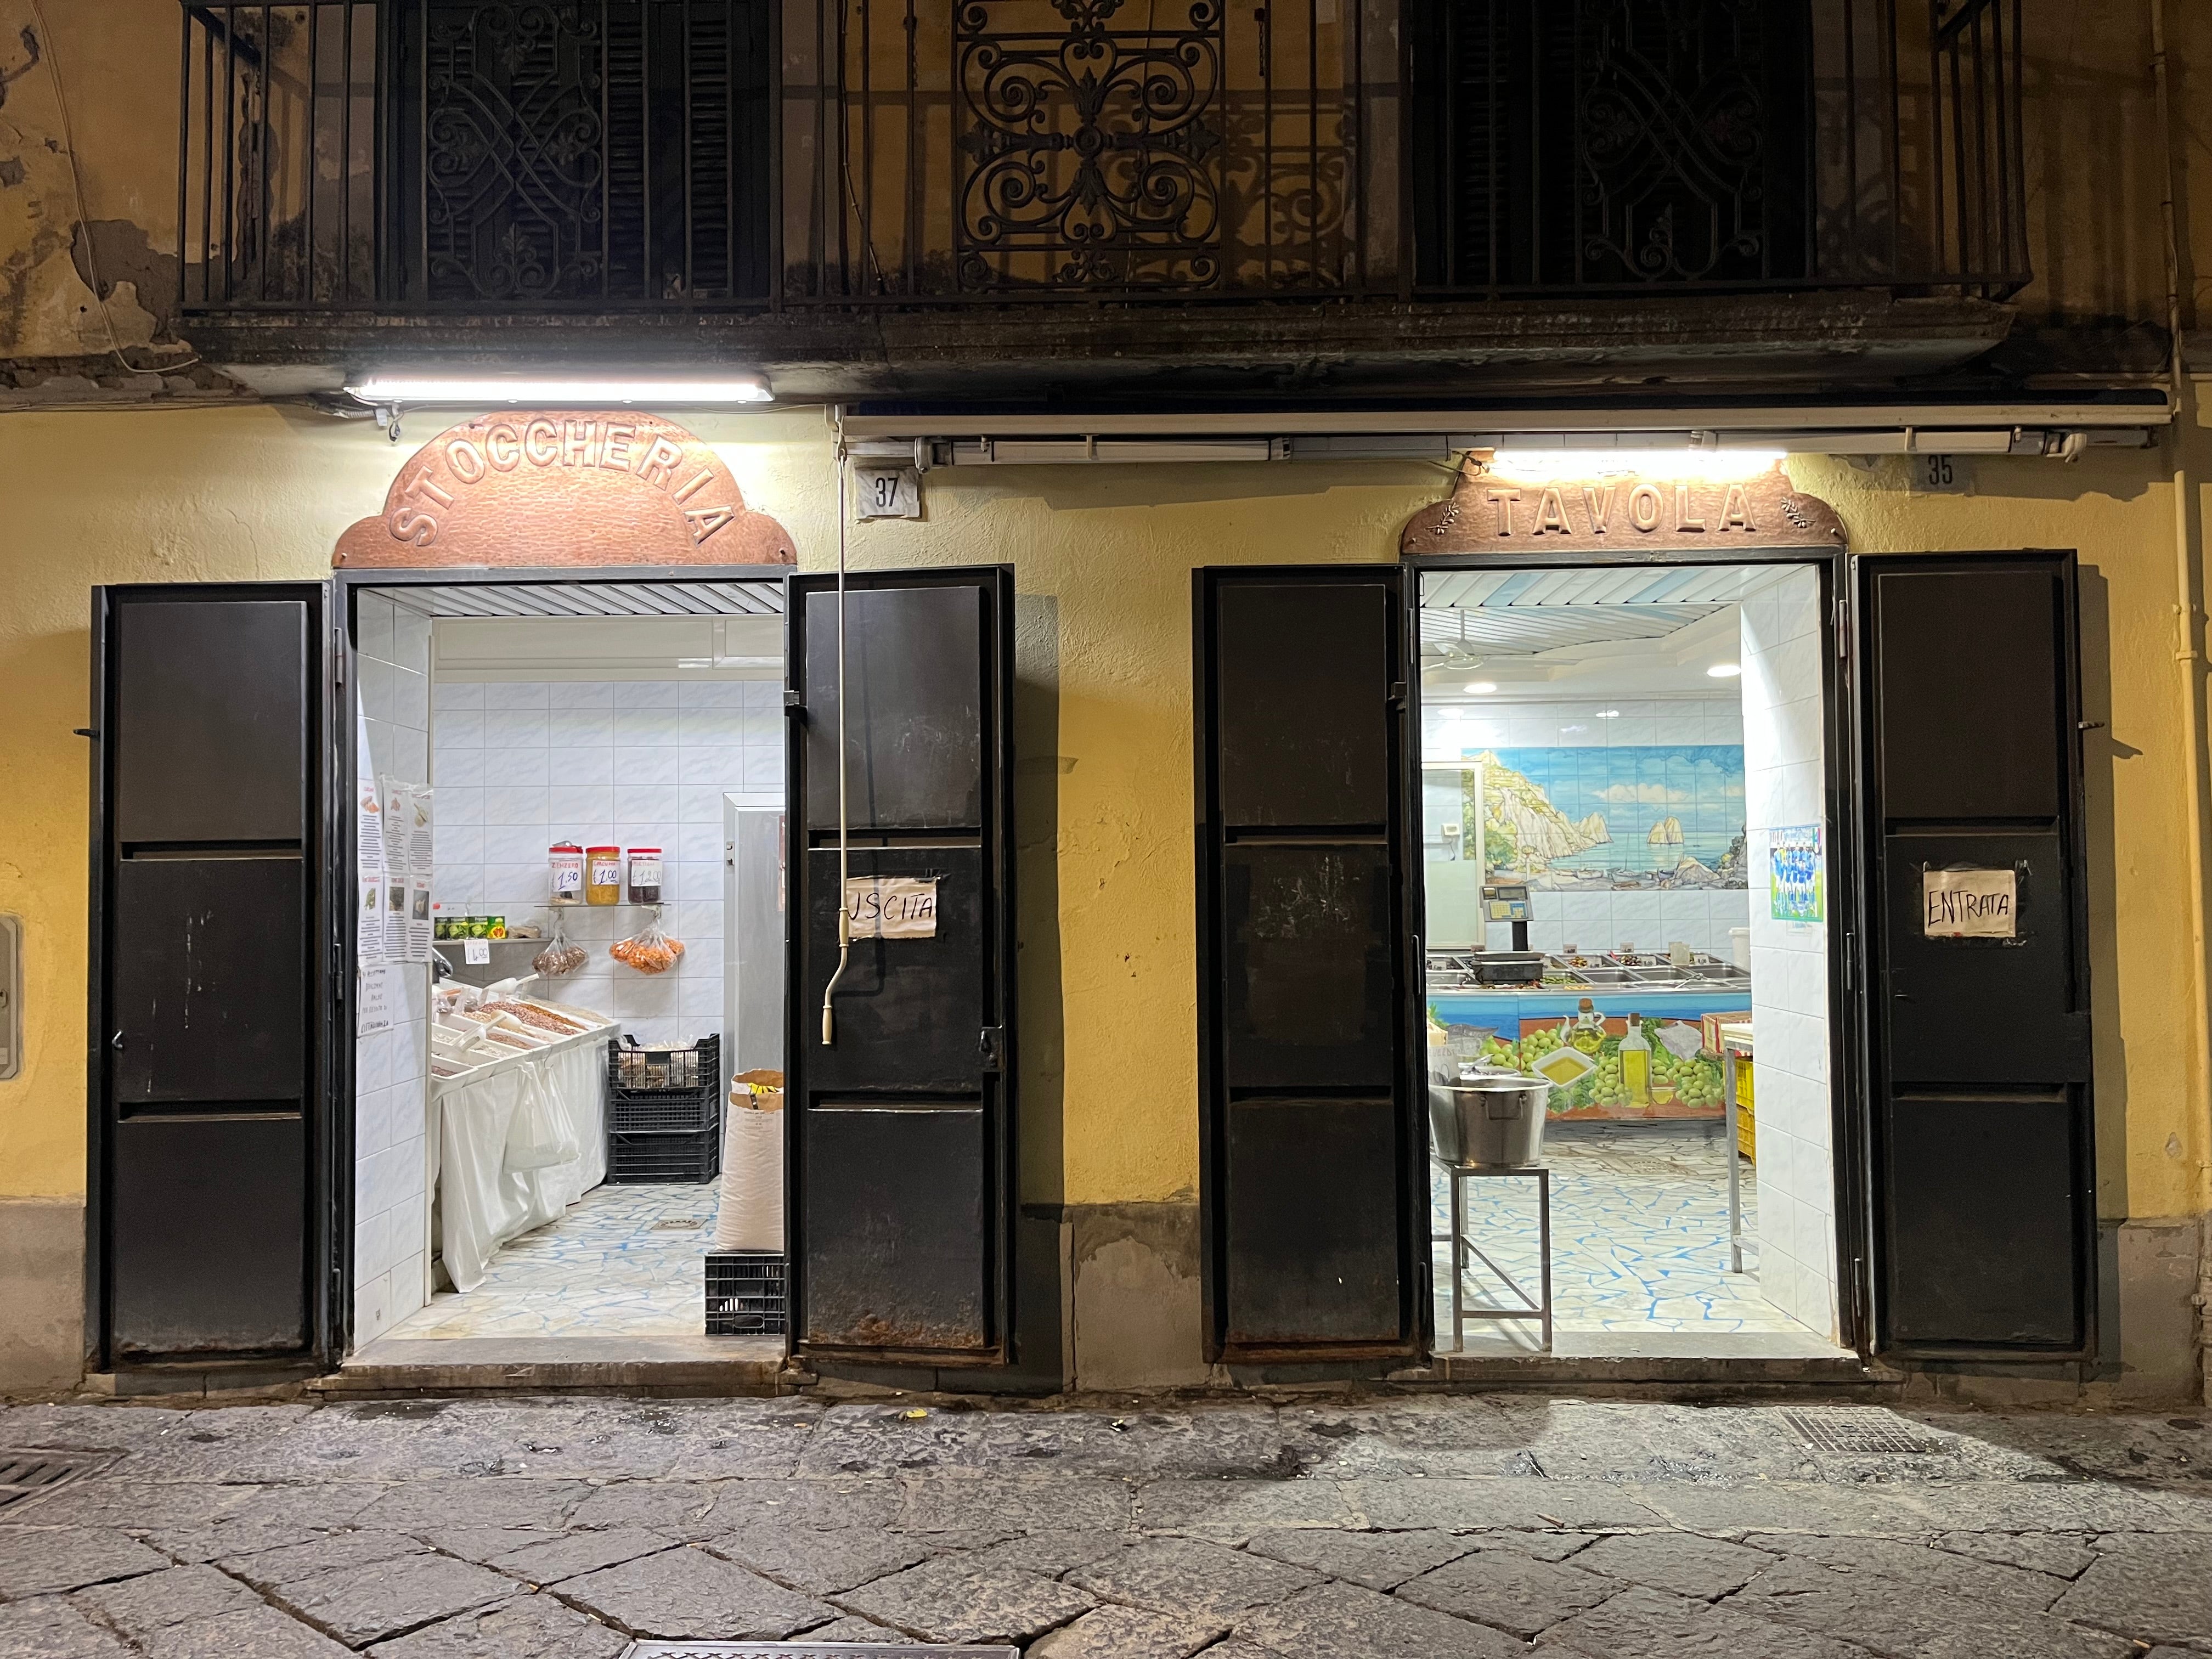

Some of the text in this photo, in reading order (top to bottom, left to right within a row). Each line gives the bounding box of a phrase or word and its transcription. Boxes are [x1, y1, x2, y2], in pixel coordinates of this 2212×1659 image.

[389, 419, 735, 548] STOCCHERIA
[1928, 454, 1953, 484] 35
[875, 477, 899, 507] 37
[1487, 483, 1757, 537] TAVOLA
[1928, 890, 2009, 928] ENTRATA
